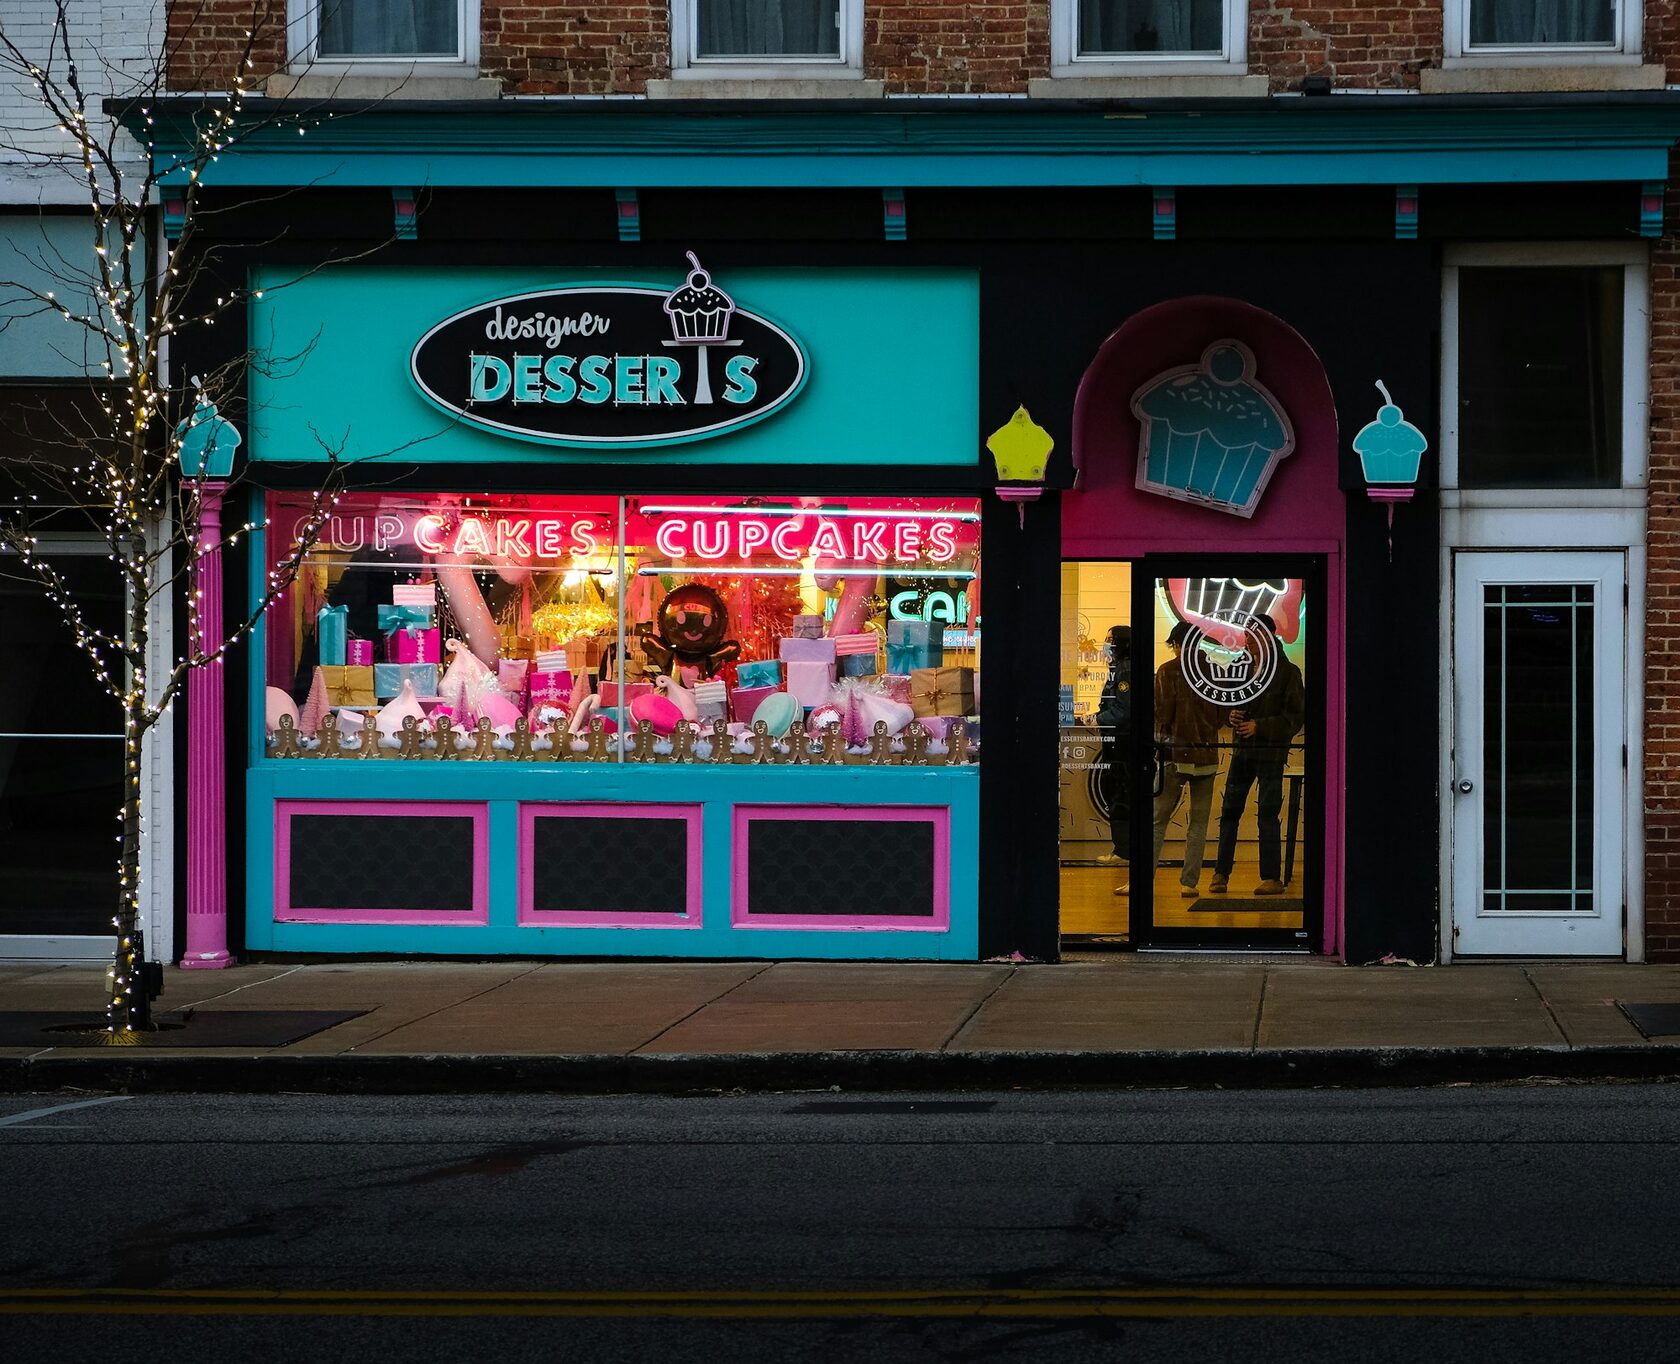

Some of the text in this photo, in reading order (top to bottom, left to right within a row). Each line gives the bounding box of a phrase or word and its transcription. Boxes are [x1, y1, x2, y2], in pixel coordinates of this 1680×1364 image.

[485, 306, 610, 349] designer
[466, 342, 761, 407] DESSERTS
[656, 519, 957, 562] CUPCAKES
[1060, 701, 1091, 712] SUNDAY
[1195, 680, 1263, 702] DESSERTS
